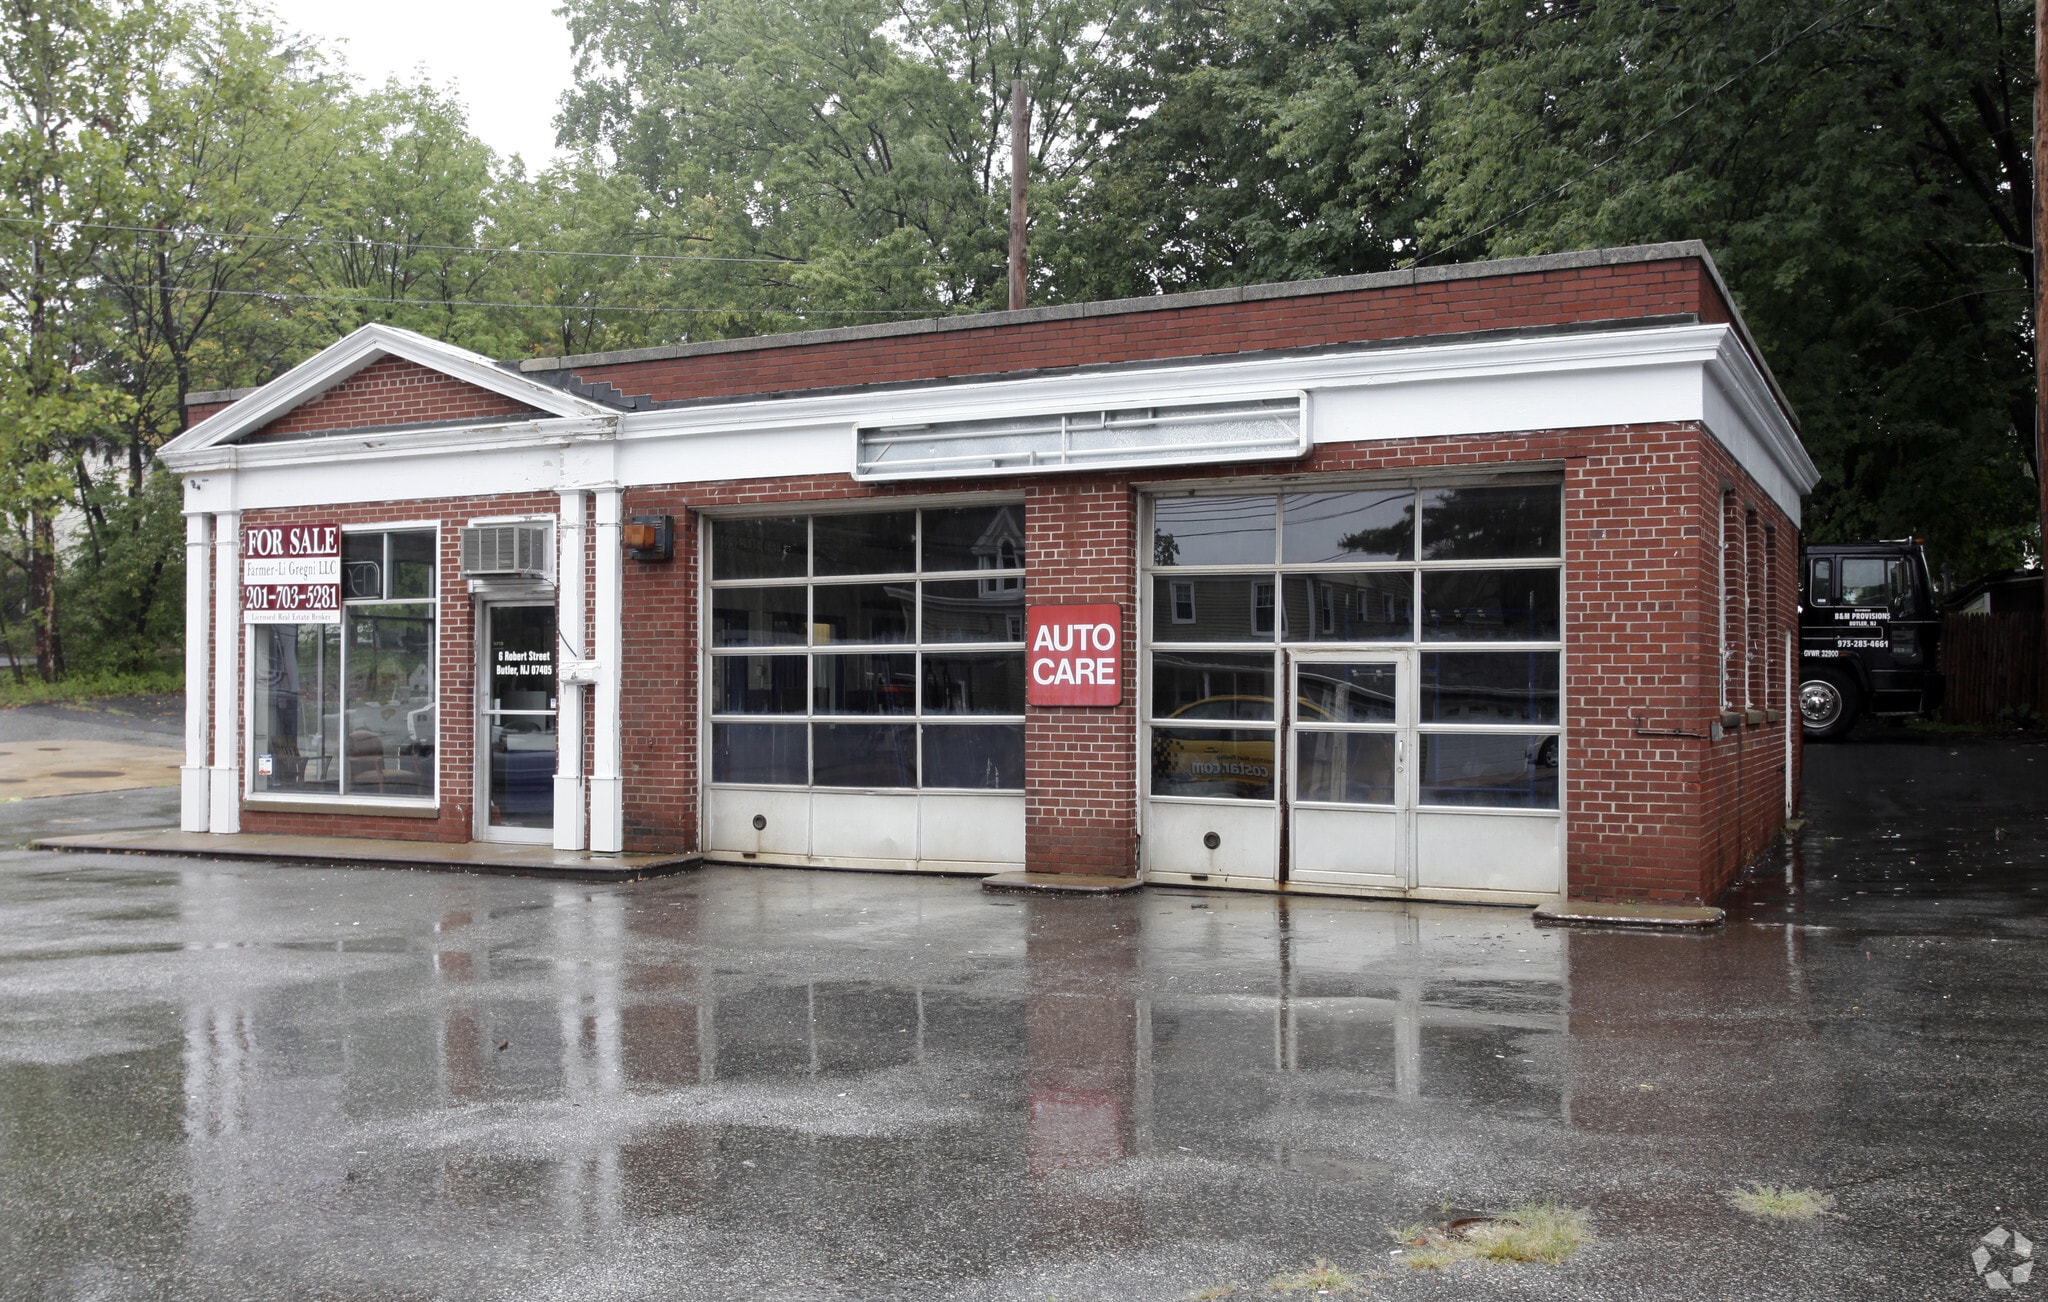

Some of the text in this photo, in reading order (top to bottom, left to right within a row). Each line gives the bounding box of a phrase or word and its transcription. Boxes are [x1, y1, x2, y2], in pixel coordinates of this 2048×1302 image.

[247, 527, 337, 556] FOR SALE
[247, 560, 337, 581] Farmer-Li Gregni LLC
[246, 585, 338, 610] 201-703-5281
[251, 612, 331, 621] Licensed Real Estate Broker
[1033, 623, 1116, 652] AUTO
[1837, 640, 1889, 648] 973-283-4661
[498, 650, 550, 661] 6 Robert Street
[496, 665, 552, 676] Butler, NJ 07405
[1032, 657, 1116, 686] CARE
